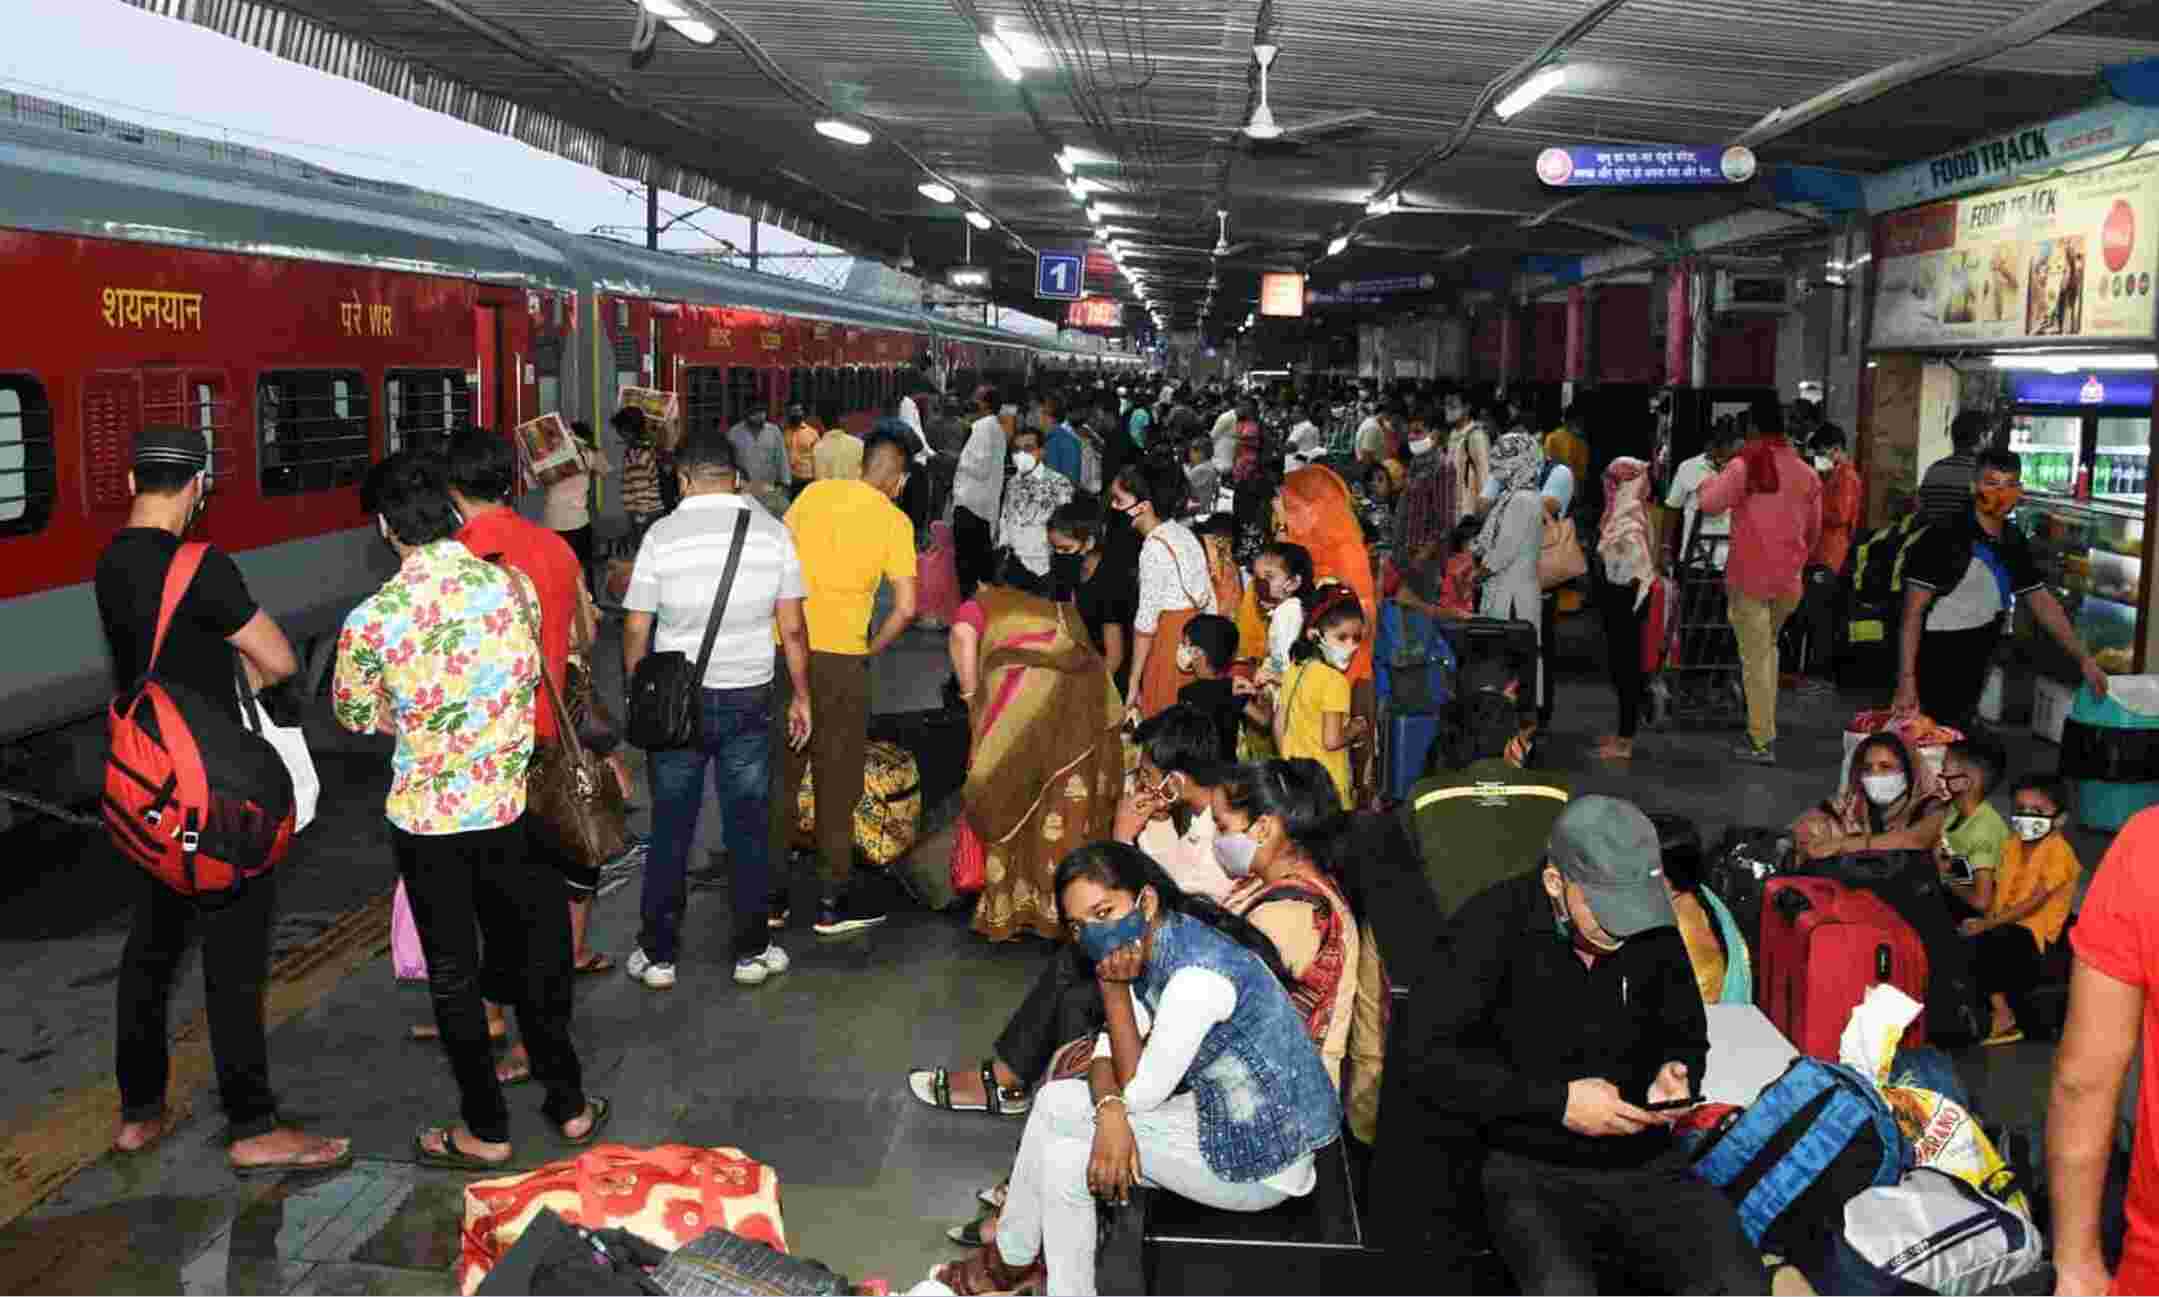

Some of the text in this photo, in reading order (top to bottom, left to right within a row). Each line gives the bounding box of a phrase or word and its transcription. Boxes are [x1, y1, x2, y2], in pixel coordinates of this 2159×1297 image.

[1930, 152, 1979, 188] FOOD
[1980, 128, 2051, 172] TRACK
[1050, 262, 1067, 290] 1
[103, 288, 202, 330] शयनयान
[368, 304, 393, 336] WR
